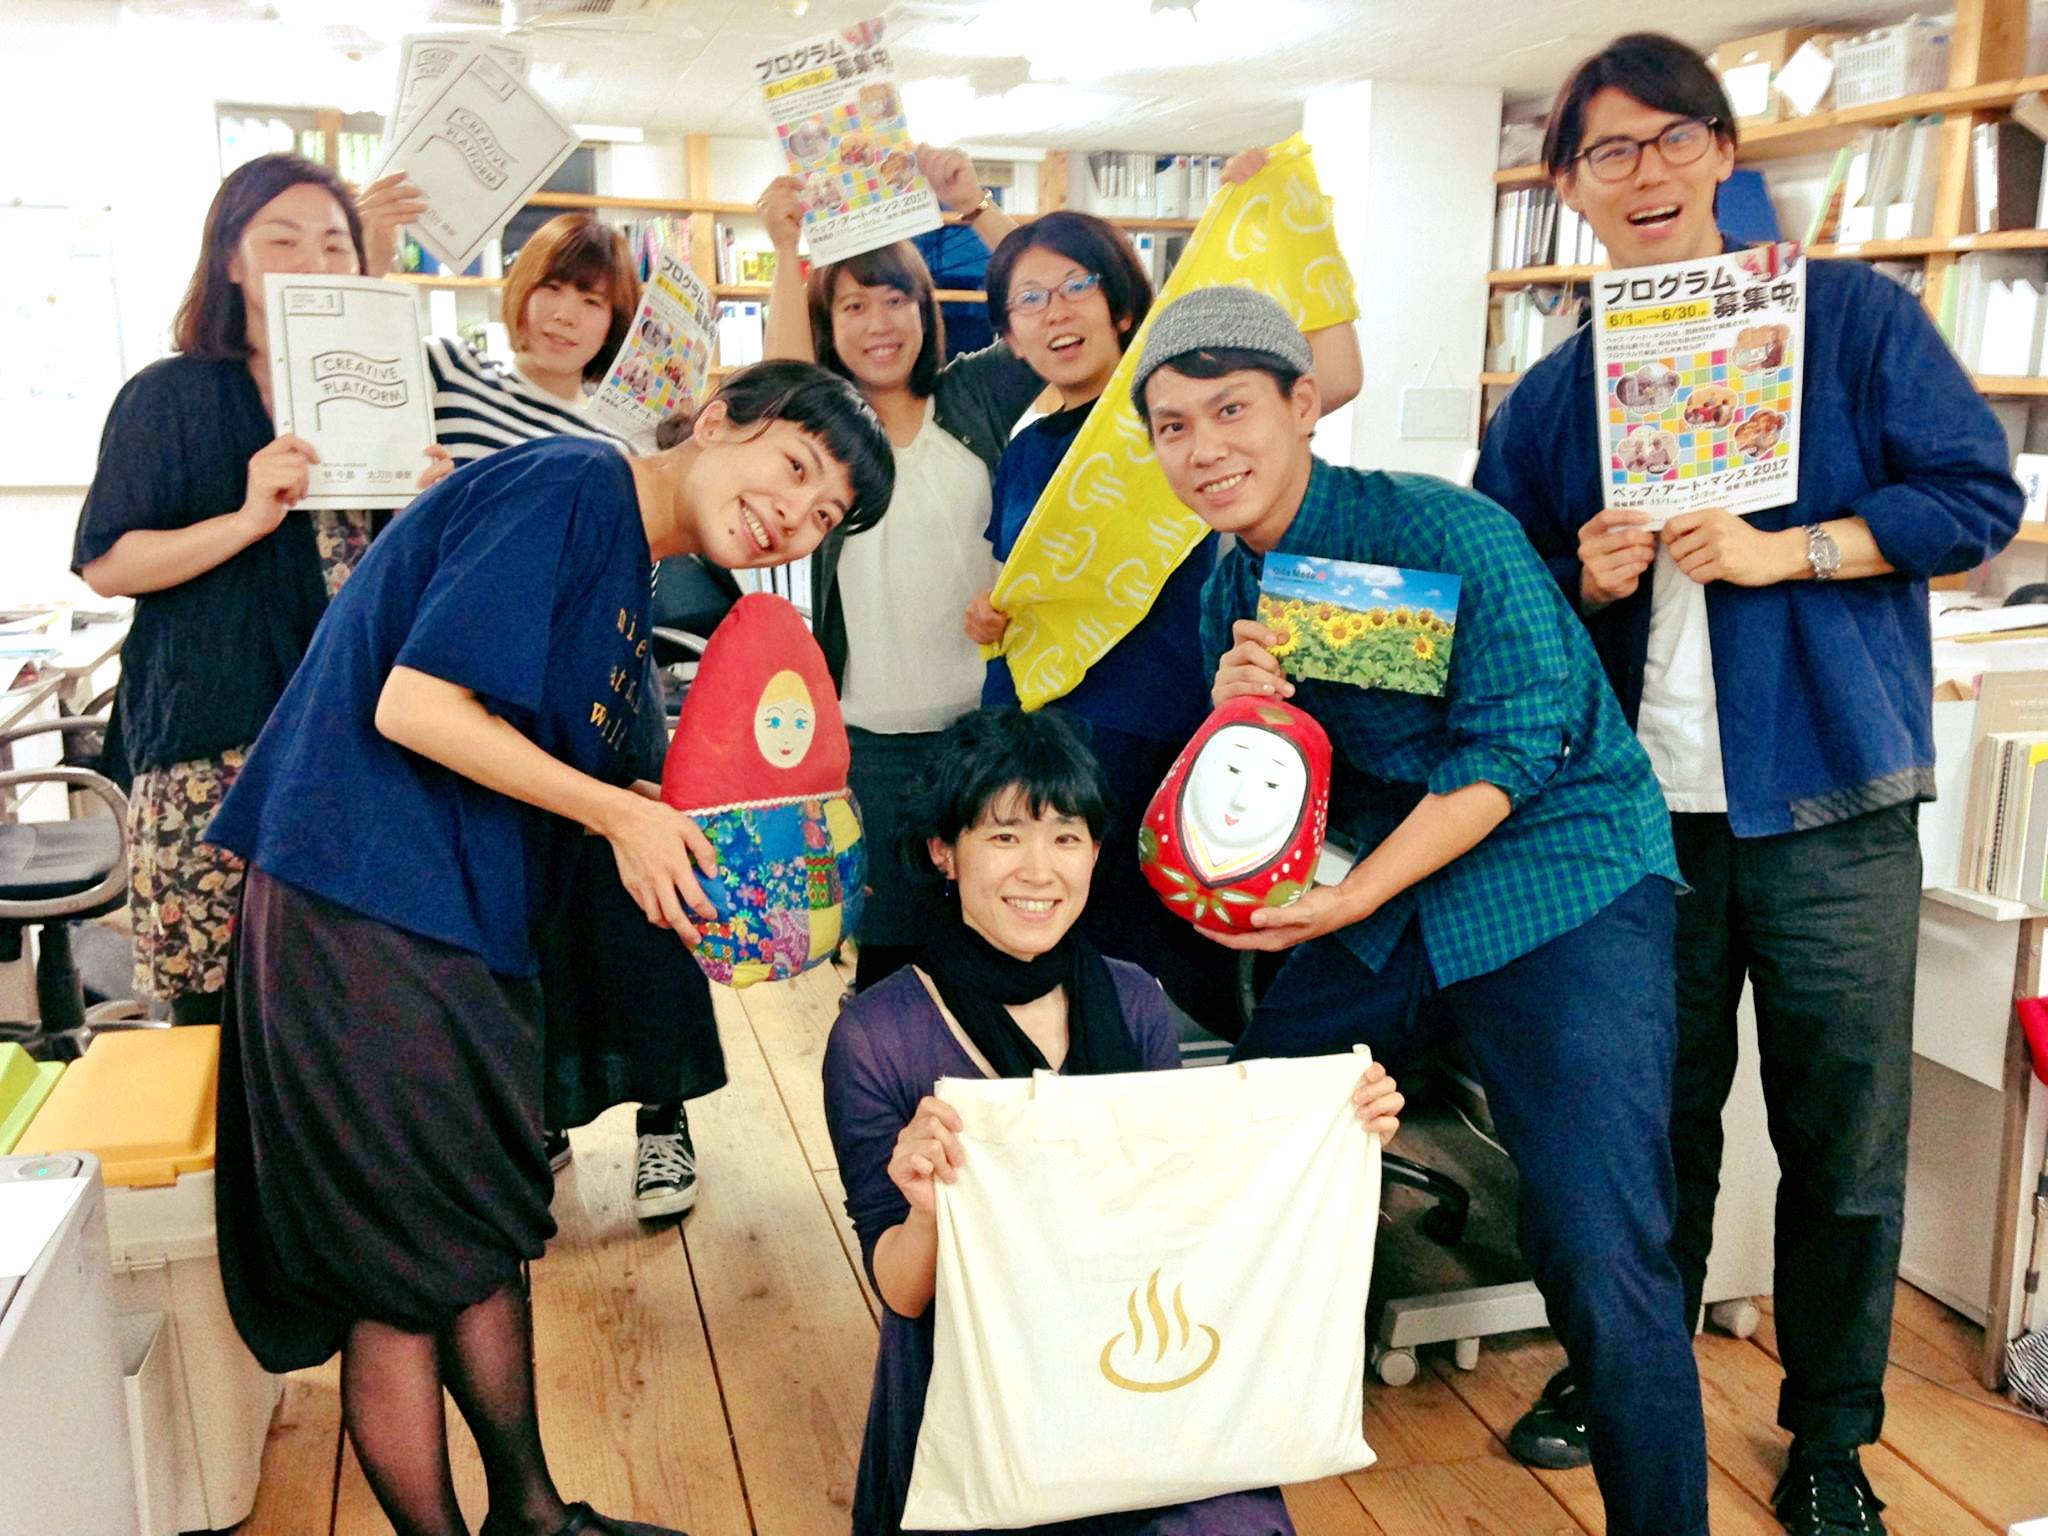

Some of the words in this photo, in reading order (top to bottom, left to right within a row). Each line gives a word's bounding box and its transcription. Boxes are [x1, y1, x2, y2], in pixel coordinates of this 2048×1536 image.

[446, 128, 497, 184] PLATFORM
[460, 115, 507, 169] CREATIVE
[1604, 265, 1737, 305] プログラム
[323, 358, 398, 379] CREATIVE
[323, 381, 402, 402] PLATFORM
[1753, 458, 1789, 476] 2017
